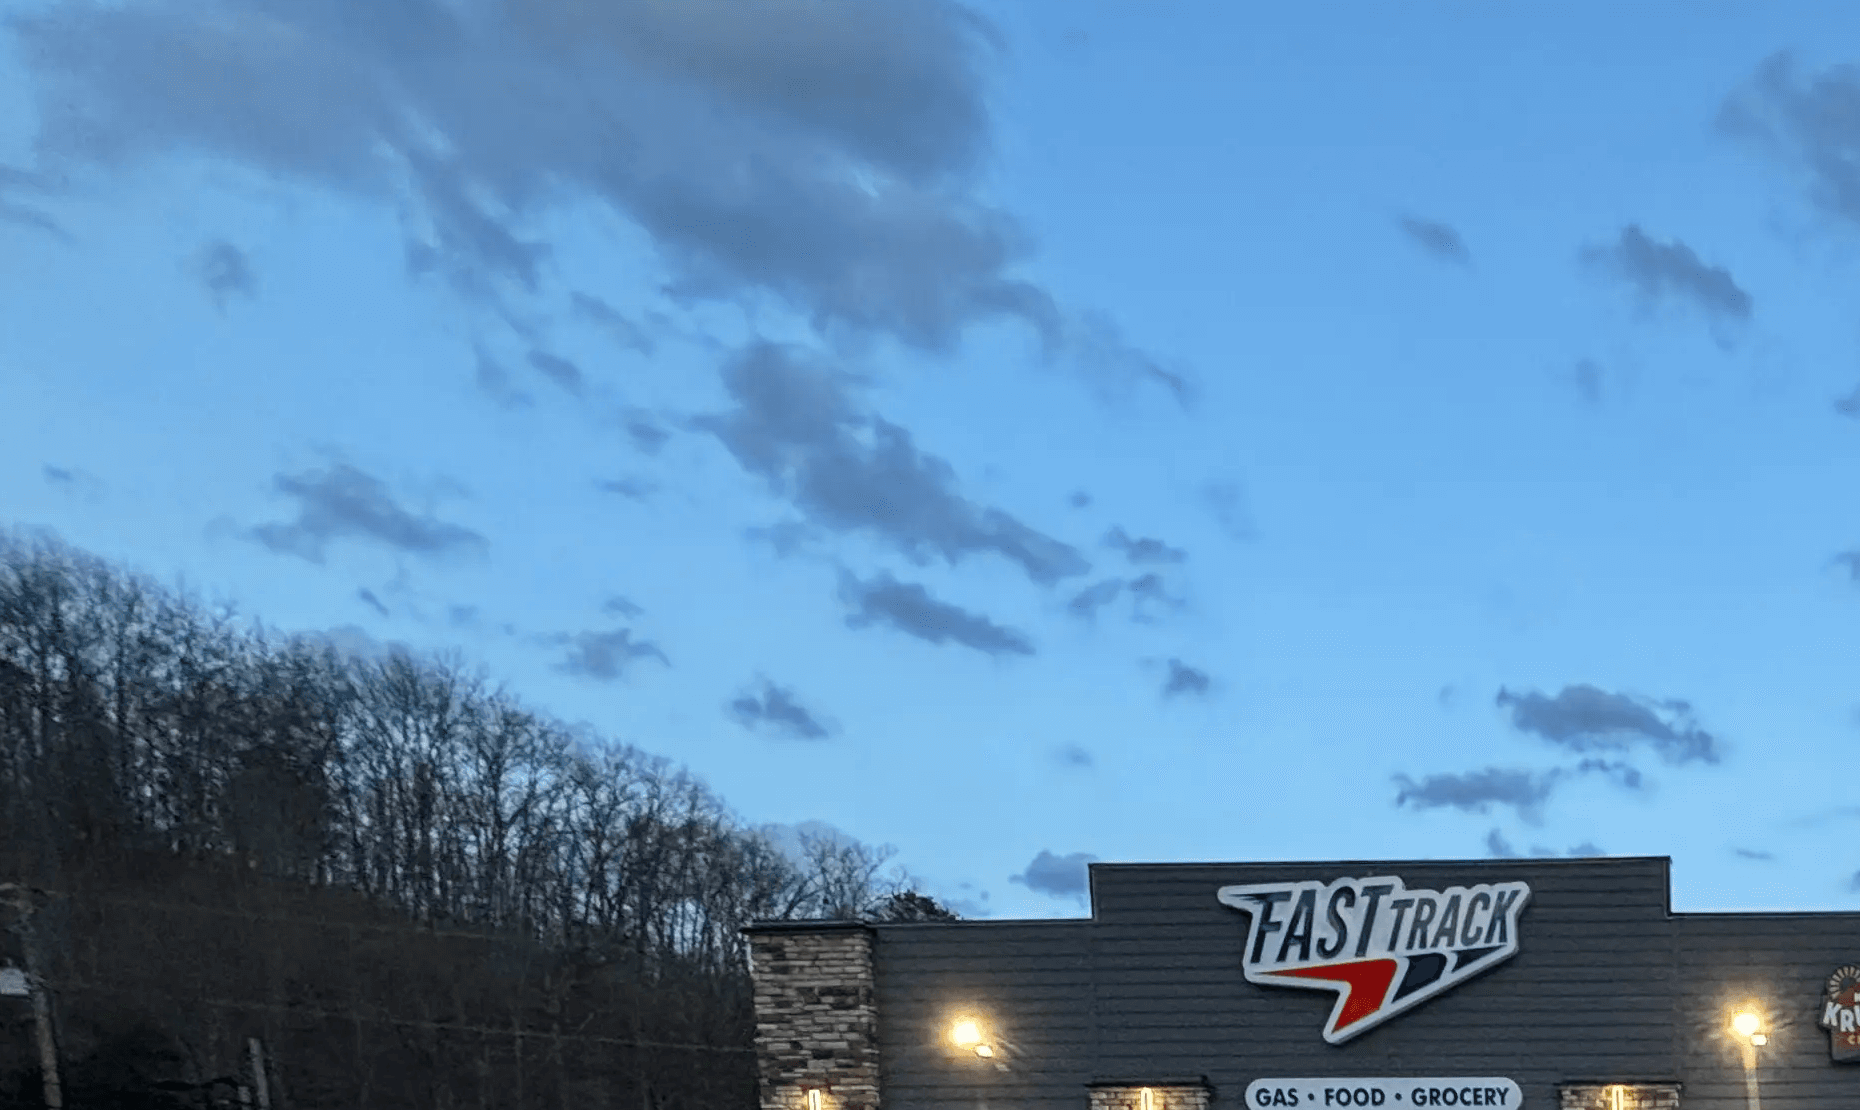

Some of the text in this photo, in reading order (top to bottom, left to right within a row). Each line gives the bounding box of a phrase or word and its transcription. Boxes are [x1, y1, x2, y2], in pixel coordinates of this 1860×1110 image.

[1228, 885, 1523, 964] FAST TRACK
[1255, 1086, 1511, 1108] GAS FOOD GROCERY
